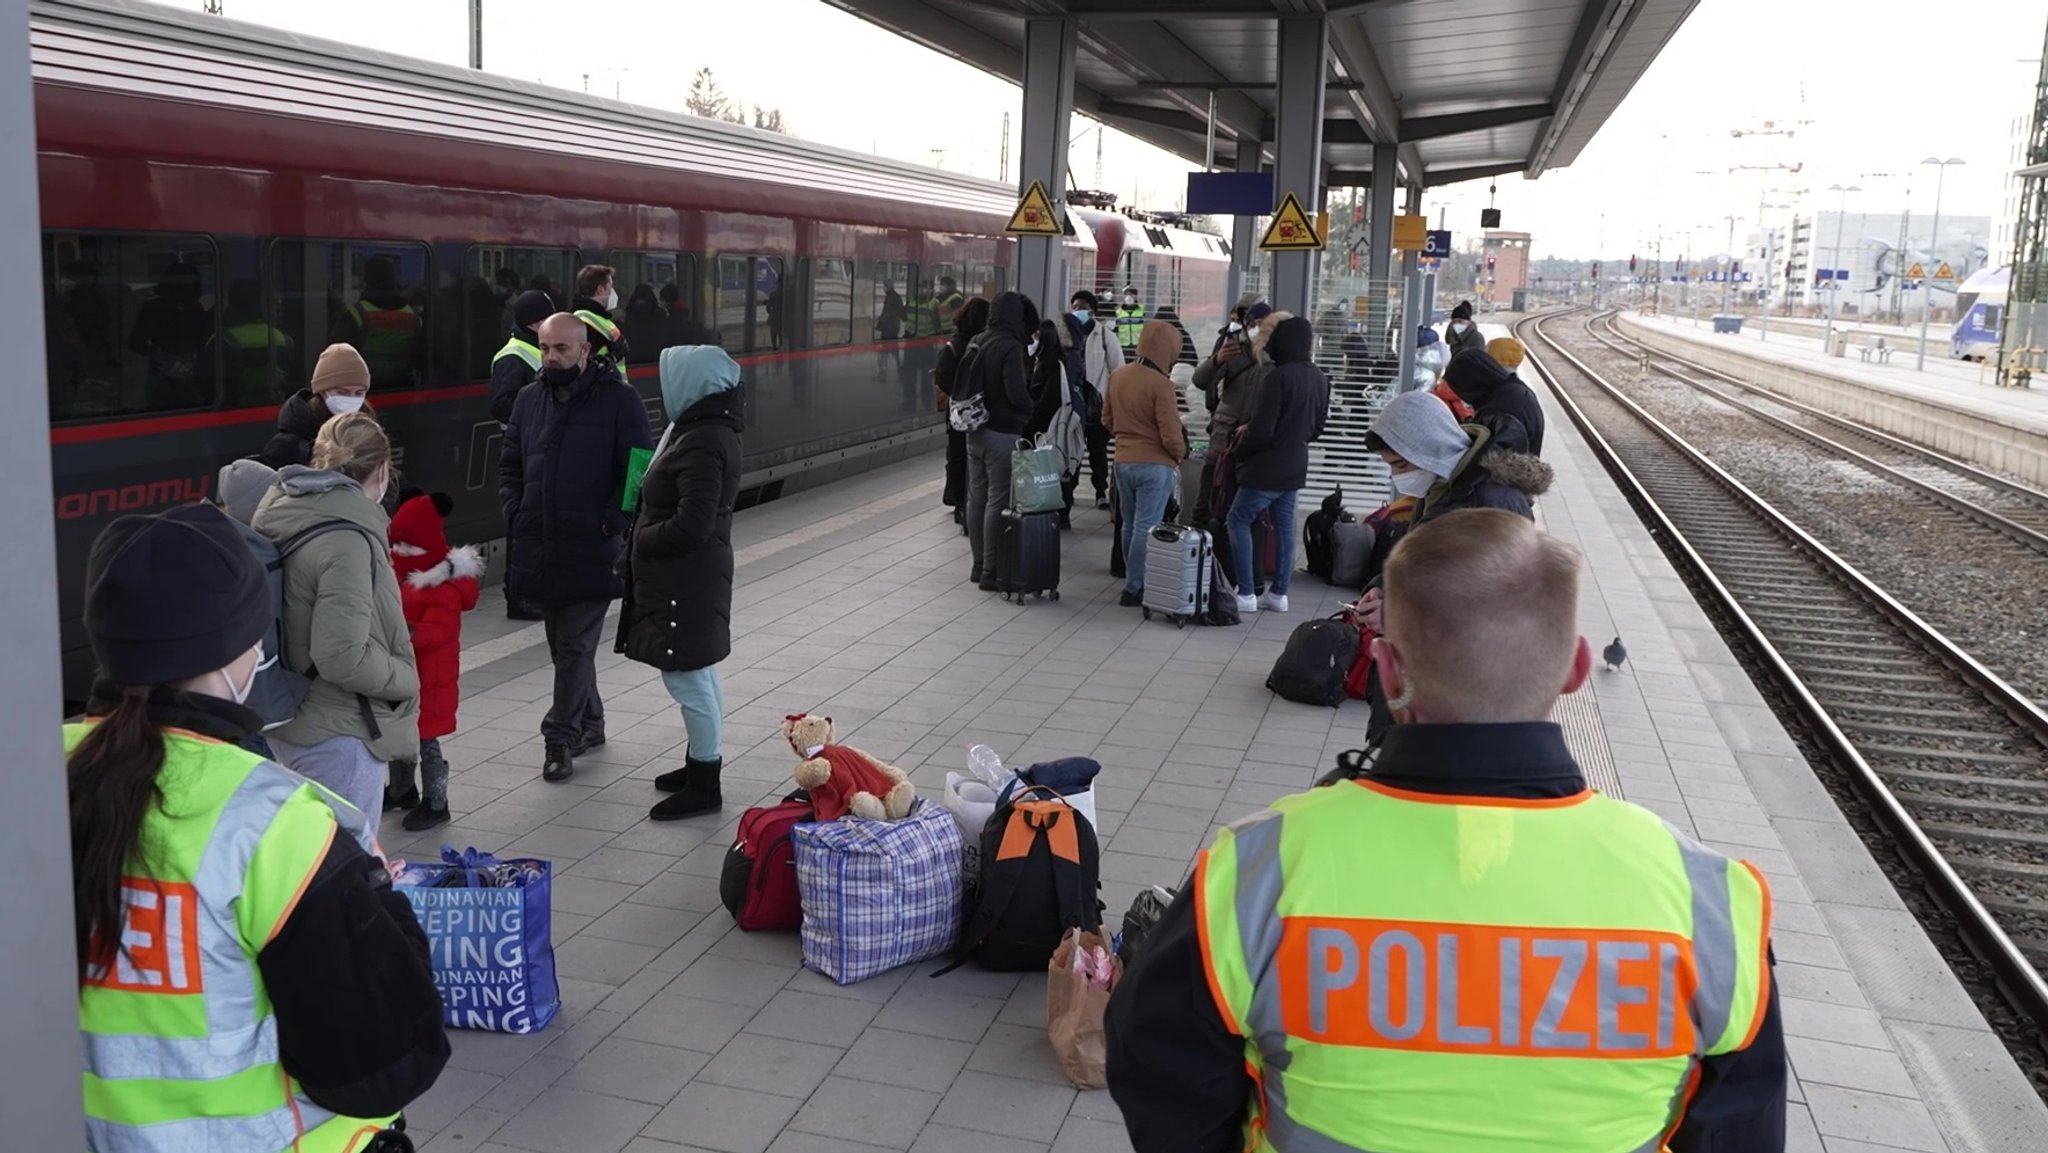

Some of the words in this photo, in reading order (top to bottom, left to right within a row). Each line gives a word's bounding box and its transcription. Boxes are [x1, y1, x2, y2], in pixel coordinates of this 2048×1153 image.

[1425, 235, 1436, 252] 6
[403, 891, 520, 907] NDINAVIAN
[87, 887, 188, 989] EI
[1308, 927, 1679, 1050] POLIZEI
